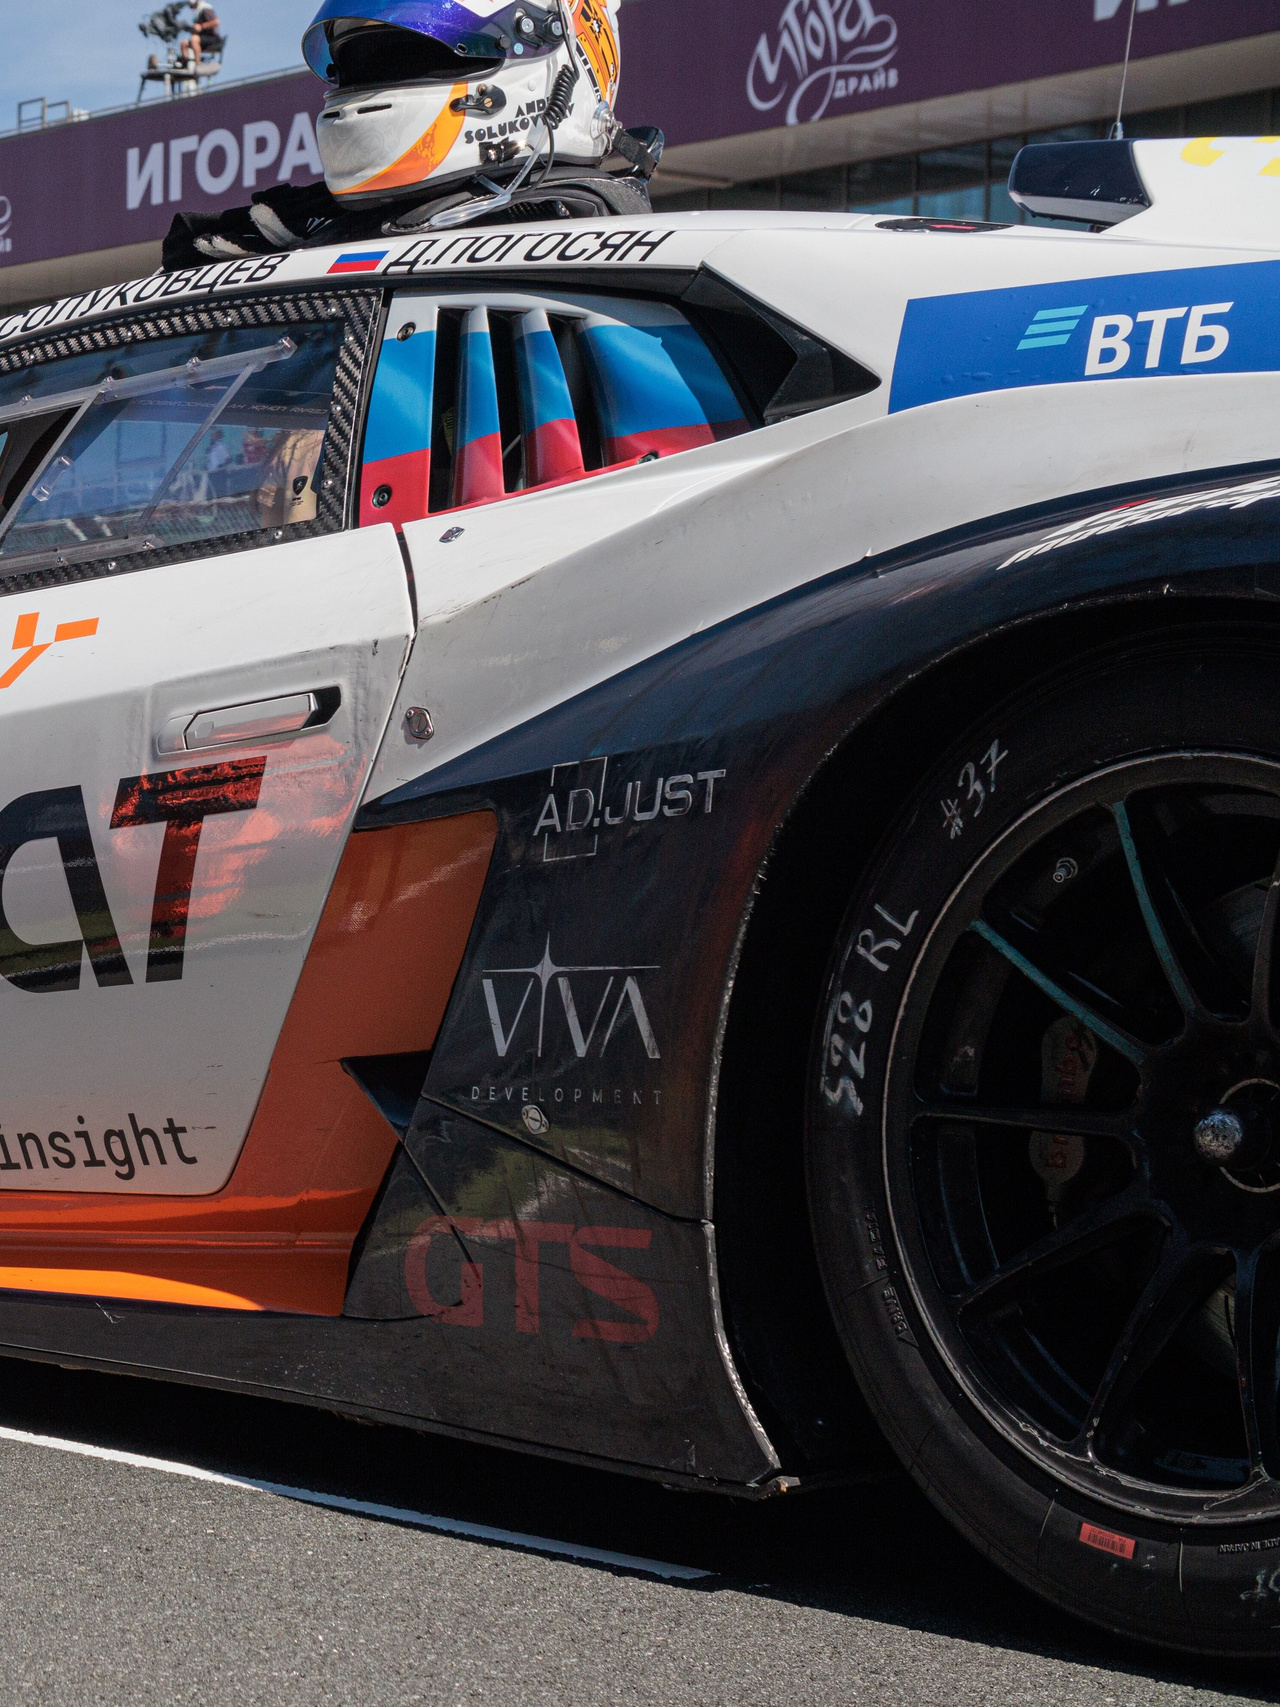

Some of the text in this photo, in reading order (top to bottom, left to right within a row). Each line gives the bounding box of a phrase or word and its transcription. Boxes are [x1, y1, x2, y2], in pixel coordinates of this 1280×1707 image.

[834, 69, 899, 98] ДРАЙВ
[126, 111, 324, 210] ИГОРА
[1084, 301, 1235, 377] ВТБ
[482, 934, 662, 1060] VIVA
[471, 1085, 663, 1105] DEVELOPMENT
[404, 1214, 661, 1344] GTS
[1262, 1537, 1280, 1548] ADE
